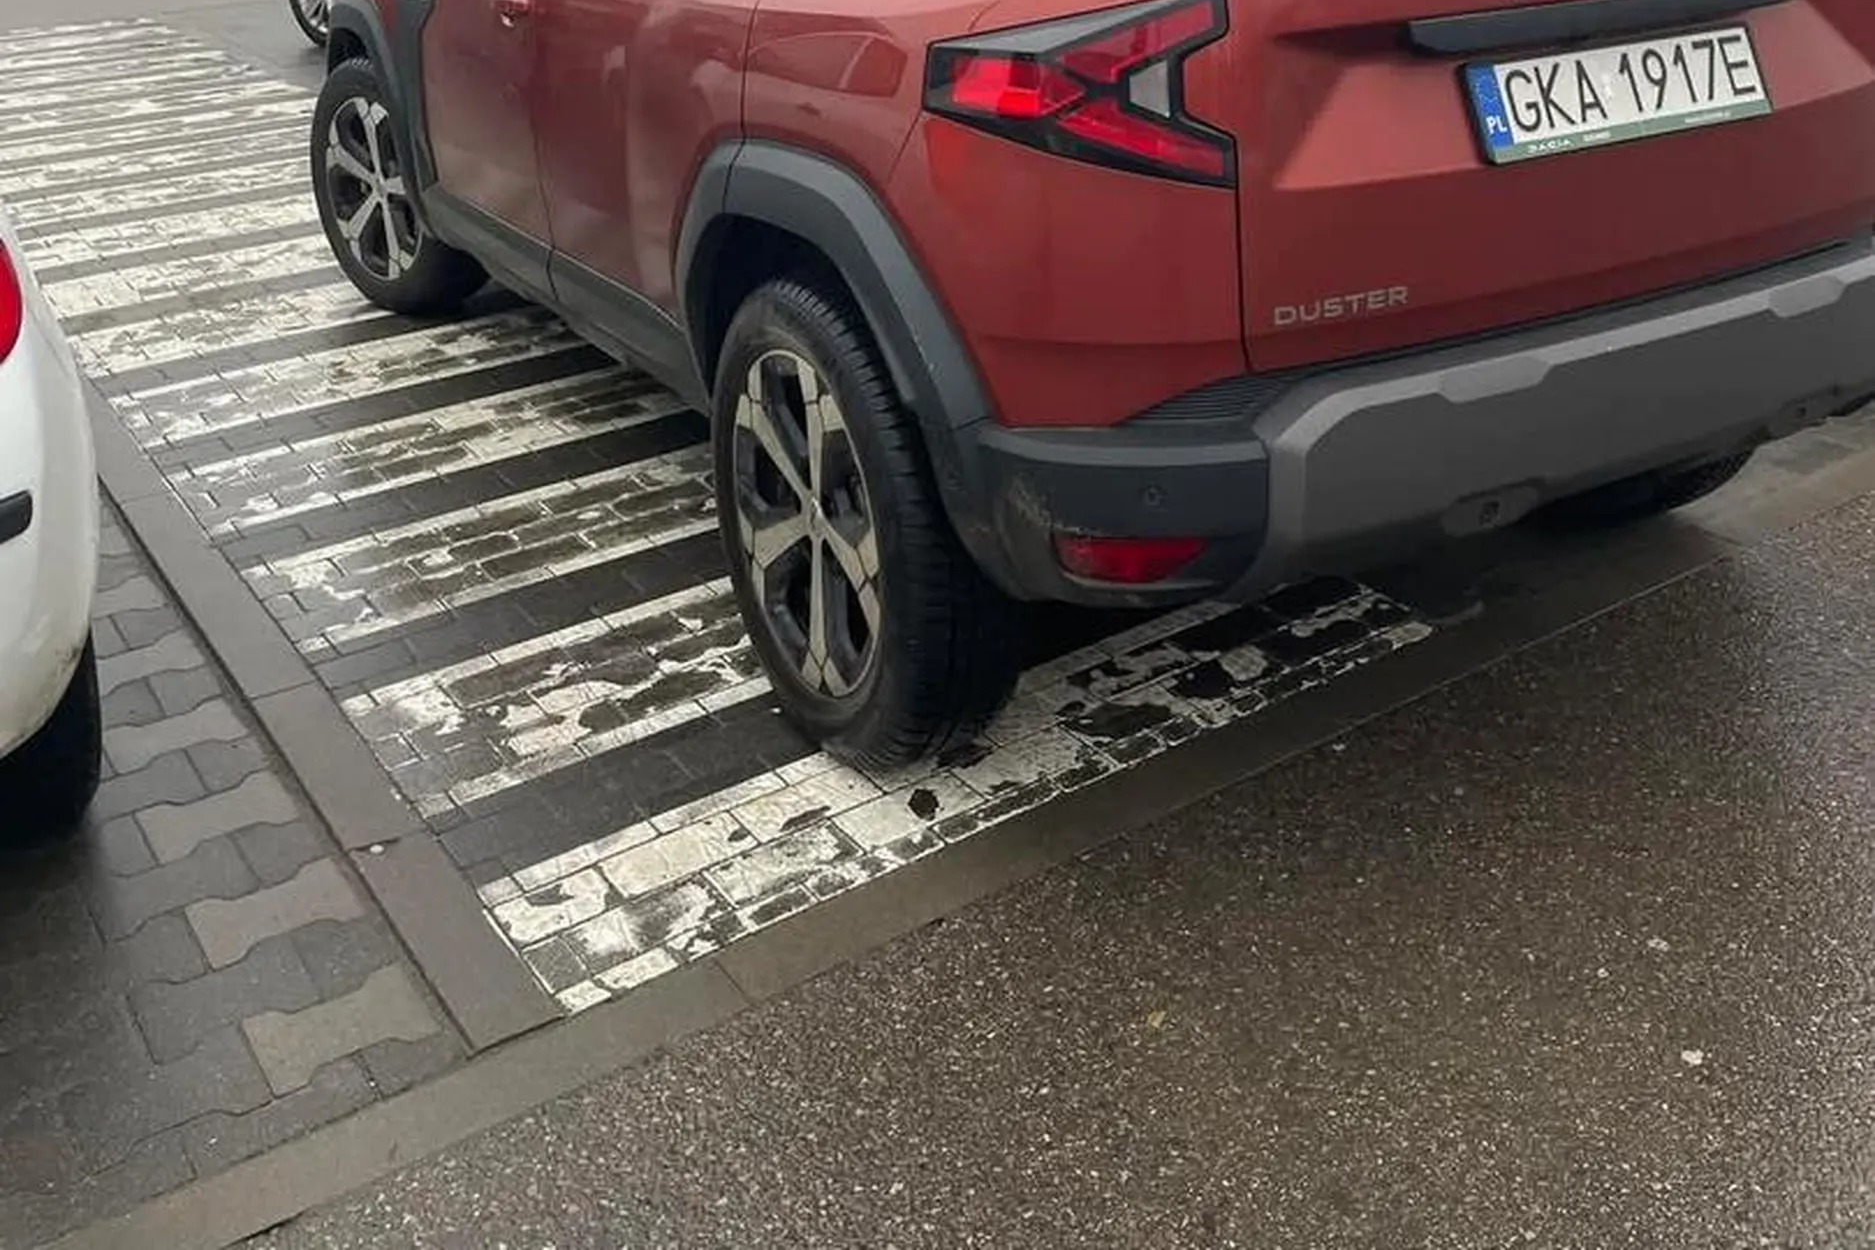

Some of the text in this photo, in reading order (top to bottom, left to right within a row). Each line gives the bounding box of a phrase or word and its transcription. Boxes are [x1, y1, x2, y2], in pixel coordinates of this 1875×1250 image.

[1504, 34, 1757, 133] GKA 1917E
[1485, 115, 1508, 135] PL
[1273, 285, 1409, 326] DUSTER
